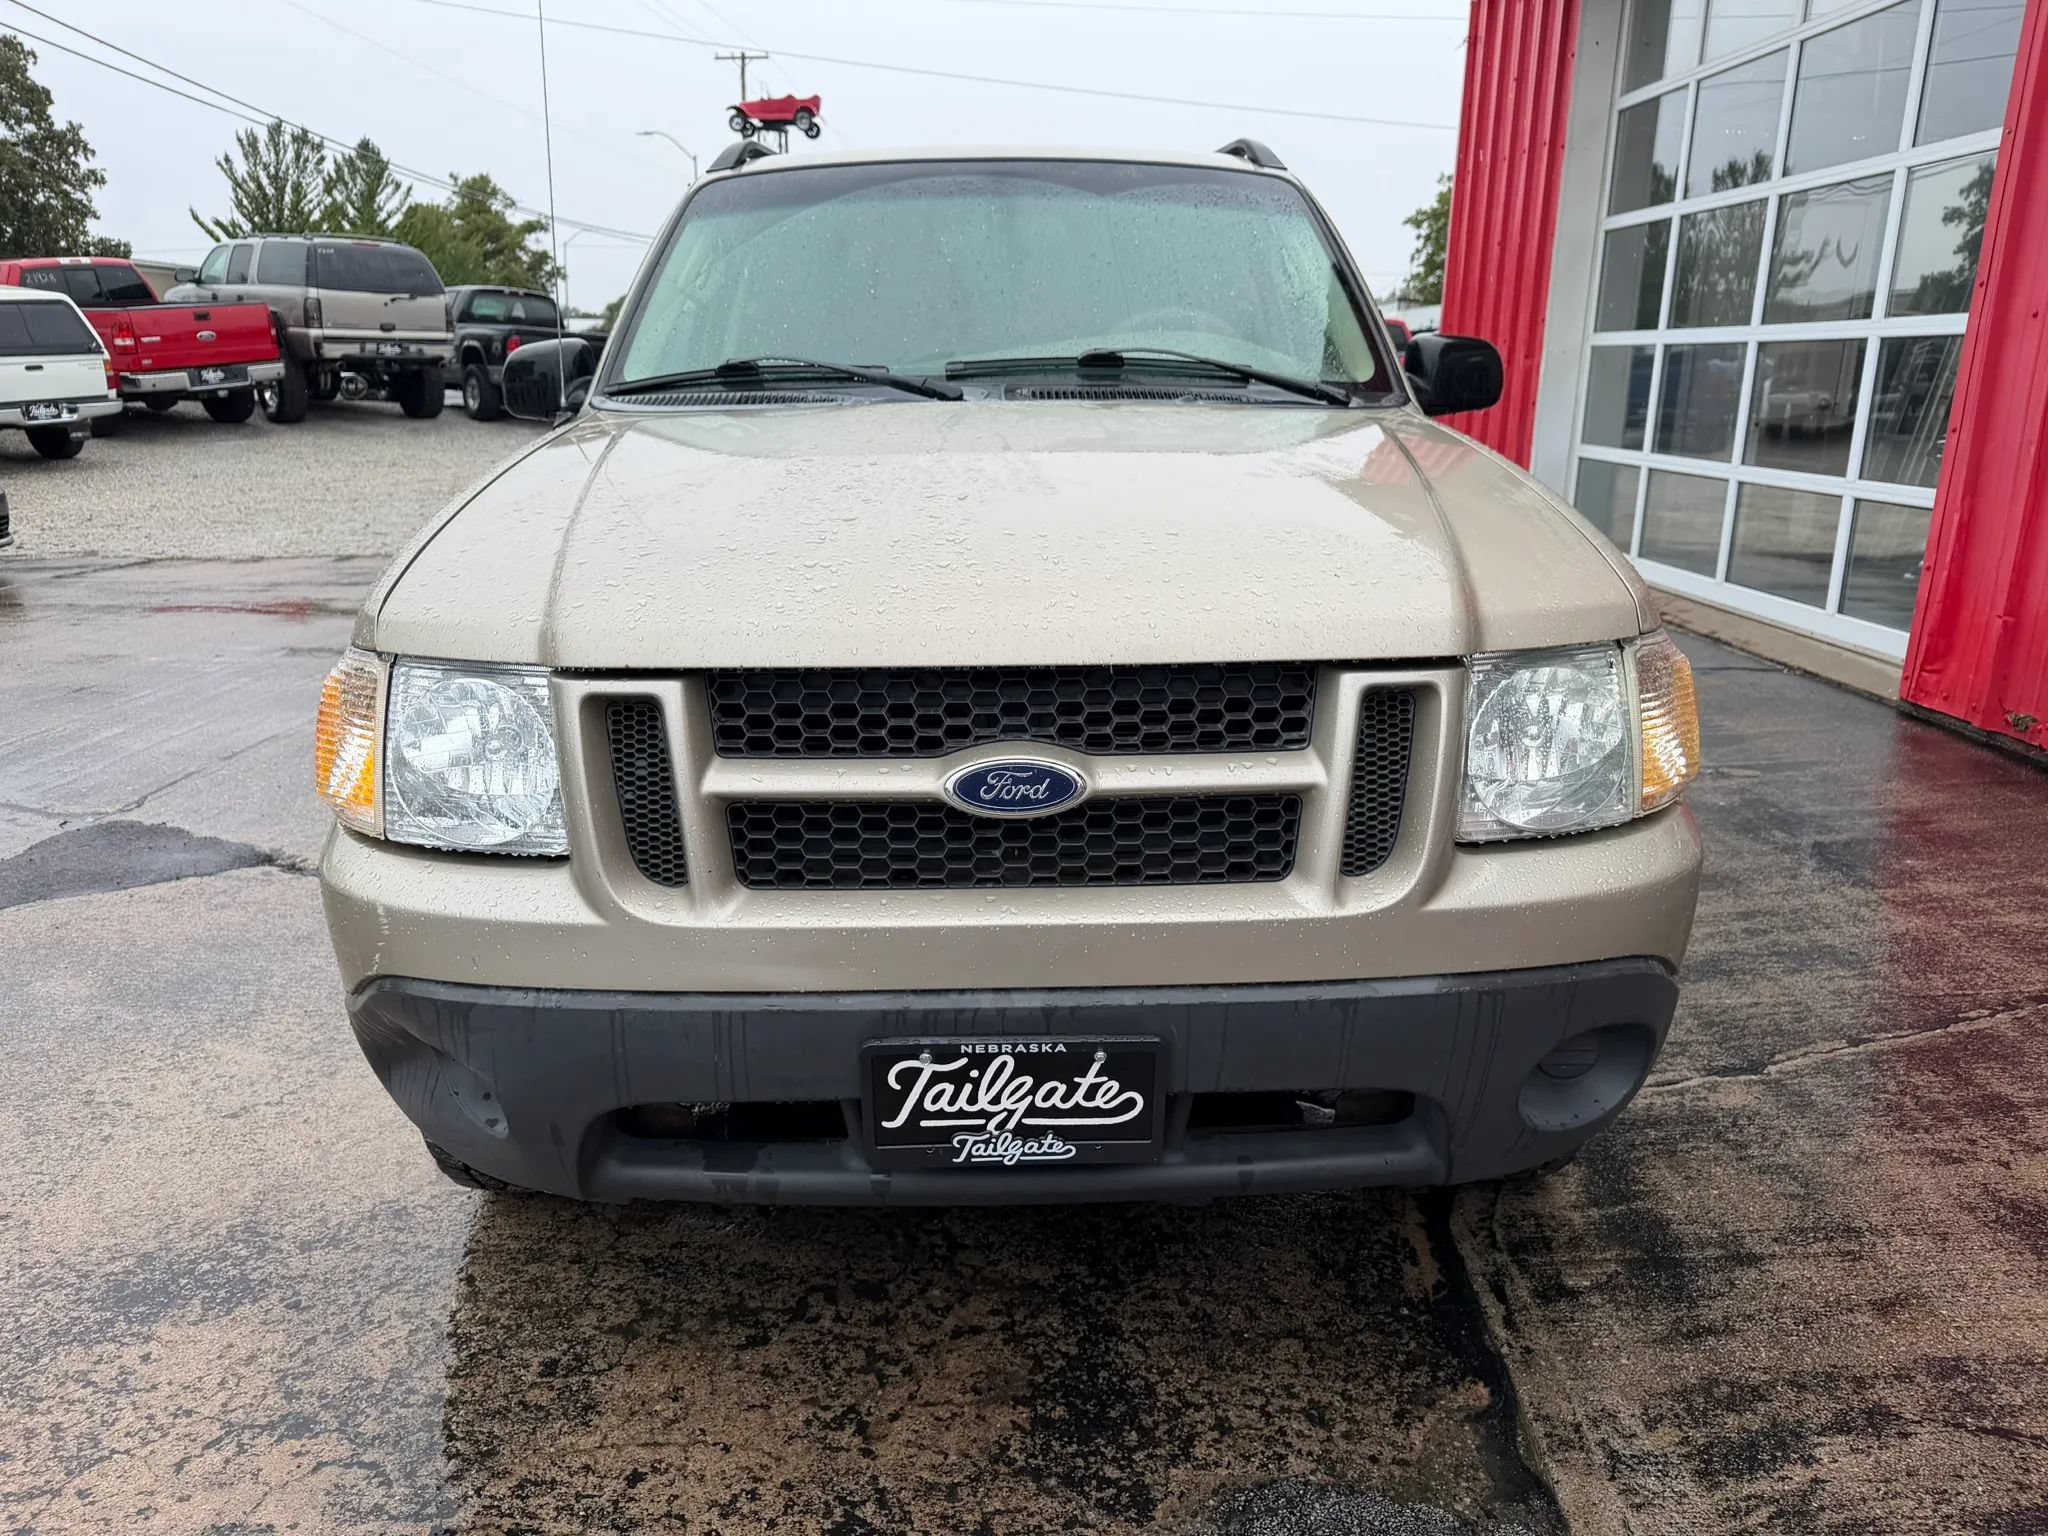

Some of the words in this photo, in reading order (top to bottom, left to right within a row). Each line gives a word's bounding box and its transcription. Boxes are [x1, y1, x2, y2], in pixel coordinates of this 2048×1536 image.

[980, 770, 1050, 800] Ford
[960, 1043, 1067, 1054] NEBRASKA
[881, 1054, 1144, 1135] Tailgate
[952, 1131, 1077, 1165] Tailgate
